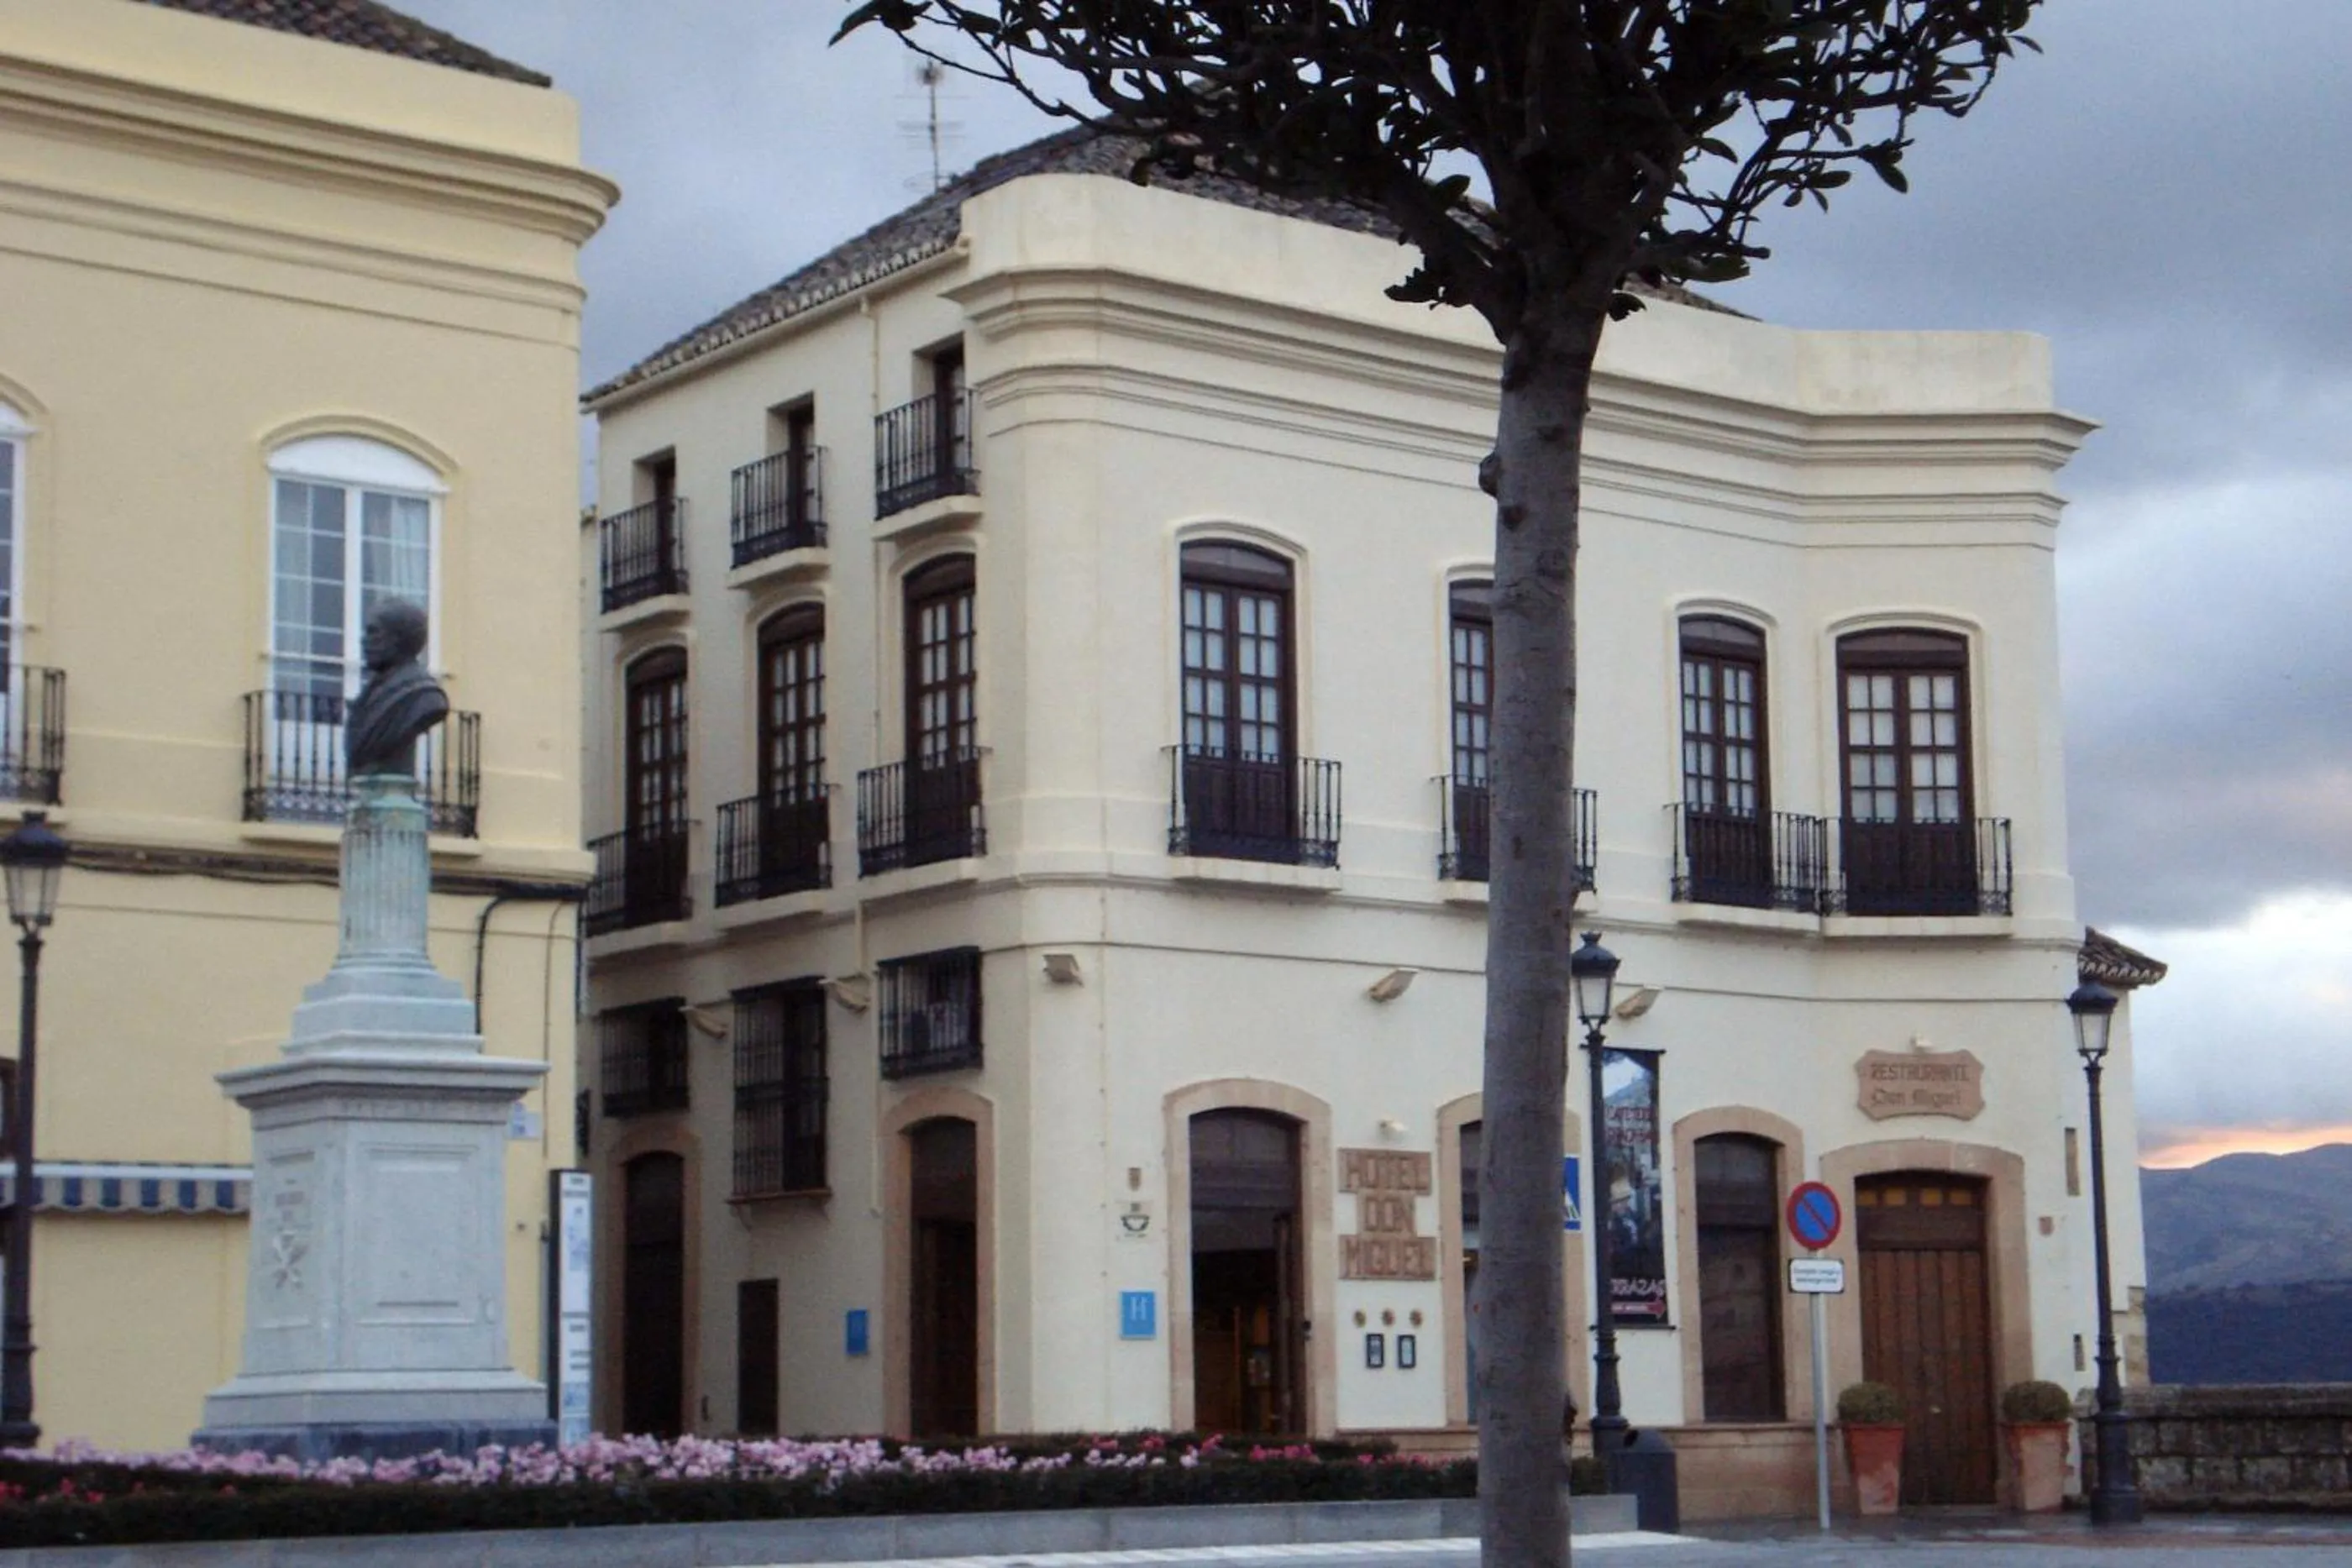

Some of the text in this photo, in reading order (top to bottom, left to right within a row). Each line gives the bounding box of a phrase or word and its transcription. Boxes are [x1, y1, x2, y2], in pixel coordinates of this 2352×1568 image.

[1342, 1153, 1430, 1190] HOTEL
[1362, 1196, 1415, 1232] DON
[1342, 1239, 1433, 1278] MIGUEL
